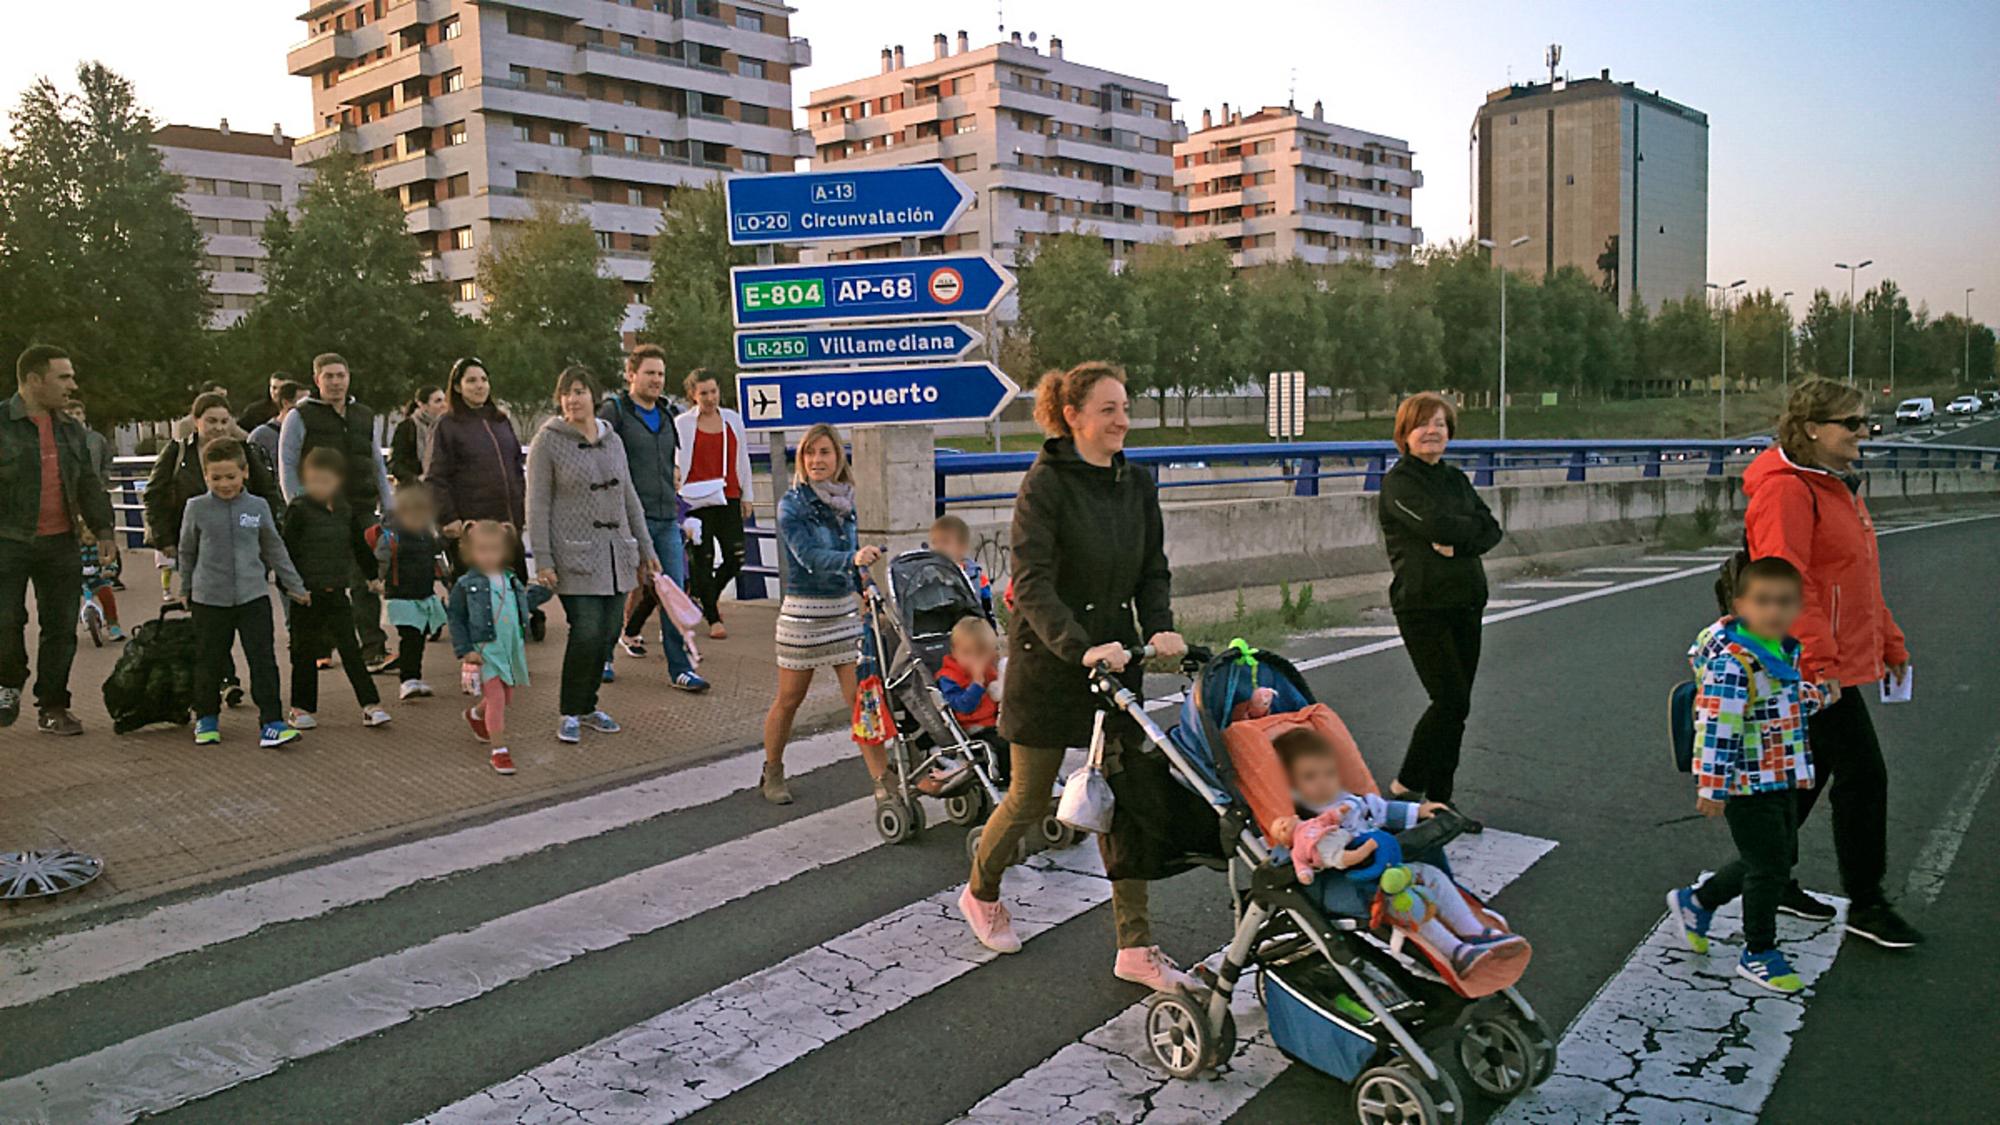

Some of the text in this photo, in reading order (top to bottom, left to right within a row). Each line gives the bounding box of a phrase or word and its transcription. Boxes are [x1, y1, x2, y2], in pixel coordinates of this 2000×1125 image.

[815, 184, 853, 201] A-13
[738, 206, 934, 231] LO-20 Circunvalación
[745, 278, 913, 307] E-804 AP-68
[747, 333, 955, 356] LR-250 Villamediana
[796, 381, 938, 411] aeropuerto
